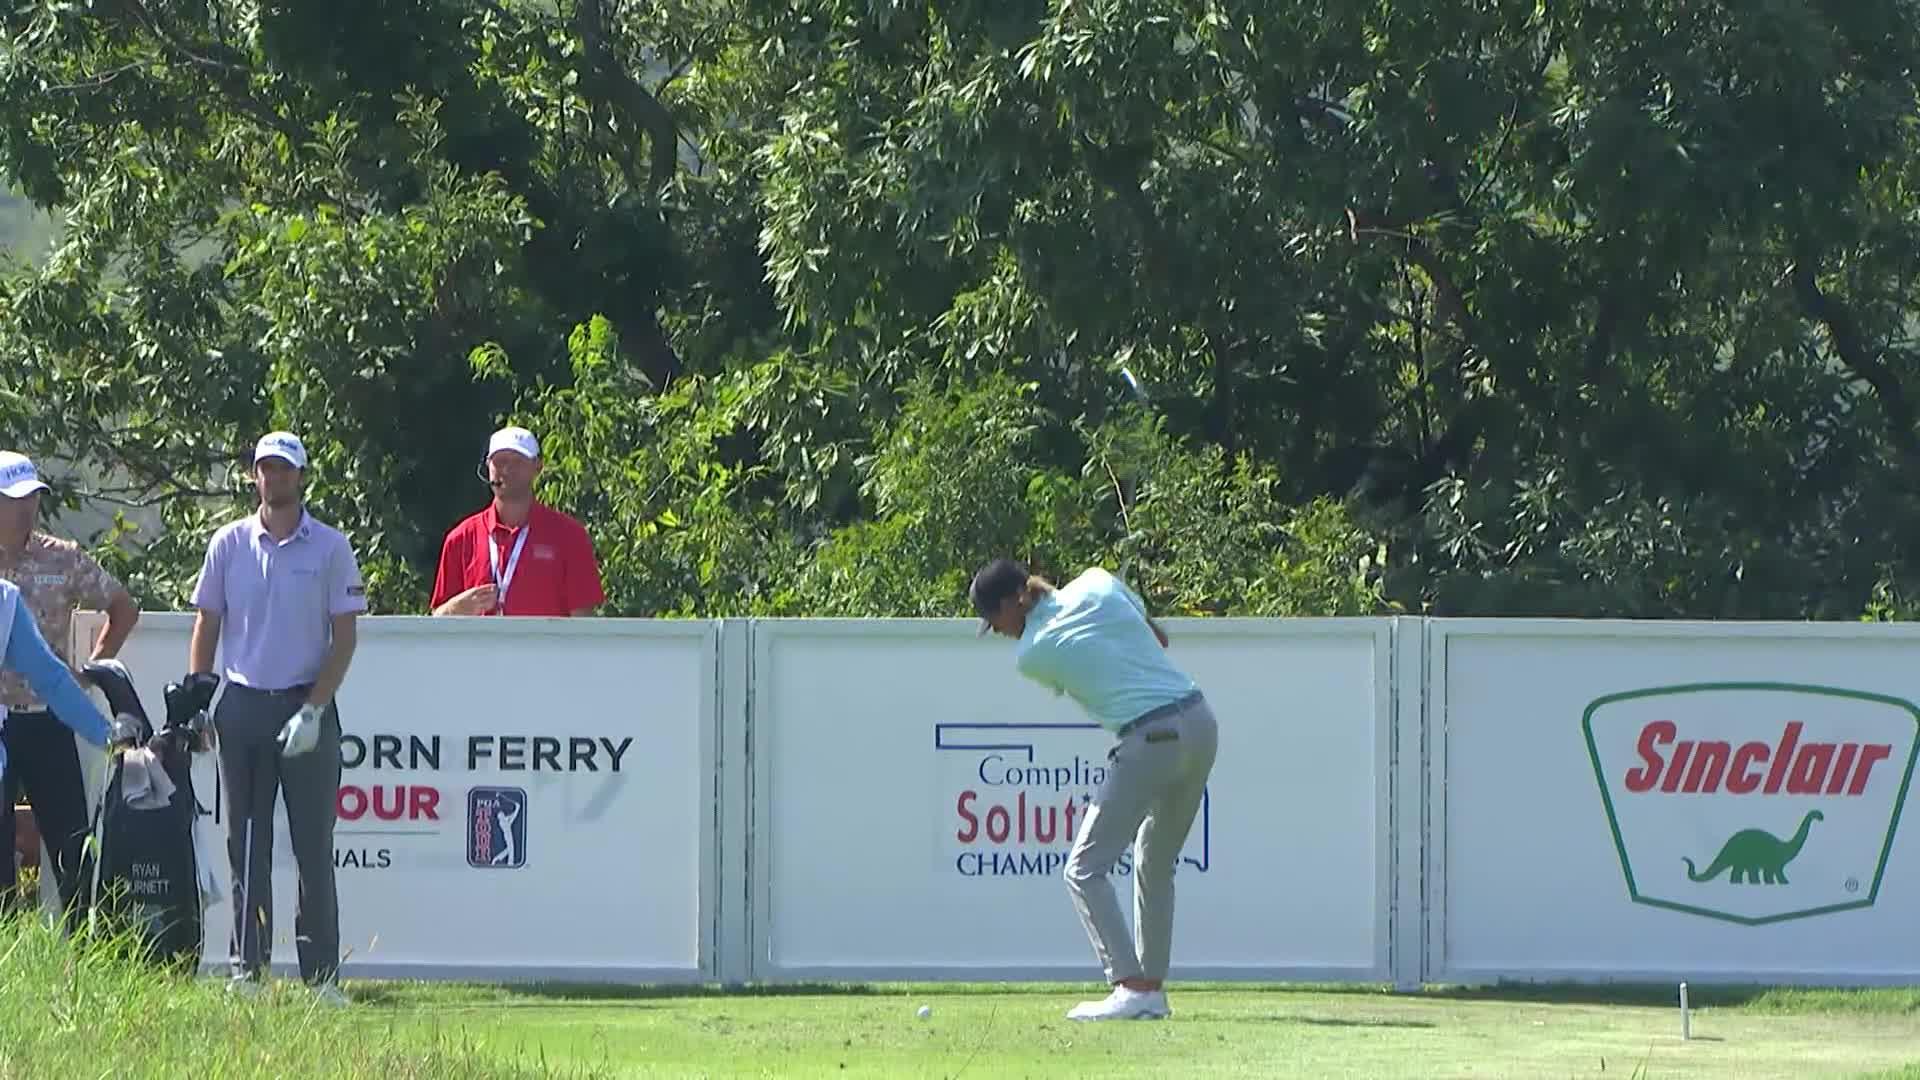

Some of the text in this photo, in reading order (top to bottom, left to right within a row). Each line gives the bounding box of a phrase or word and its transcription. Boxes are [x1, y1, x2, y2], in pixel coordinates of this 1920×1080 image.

[338, 735, 633, 772] ORN FERRY
[1625, 720, 1892, 796] Sinclair
[979, 755, 1108, 791] Complia
[336, 785, 440, 820] OUR
[957, 790, 1090, 844] Solut
[126, 879, 169, 895] URNETT
[132, 863, 160, 878] RYAN
